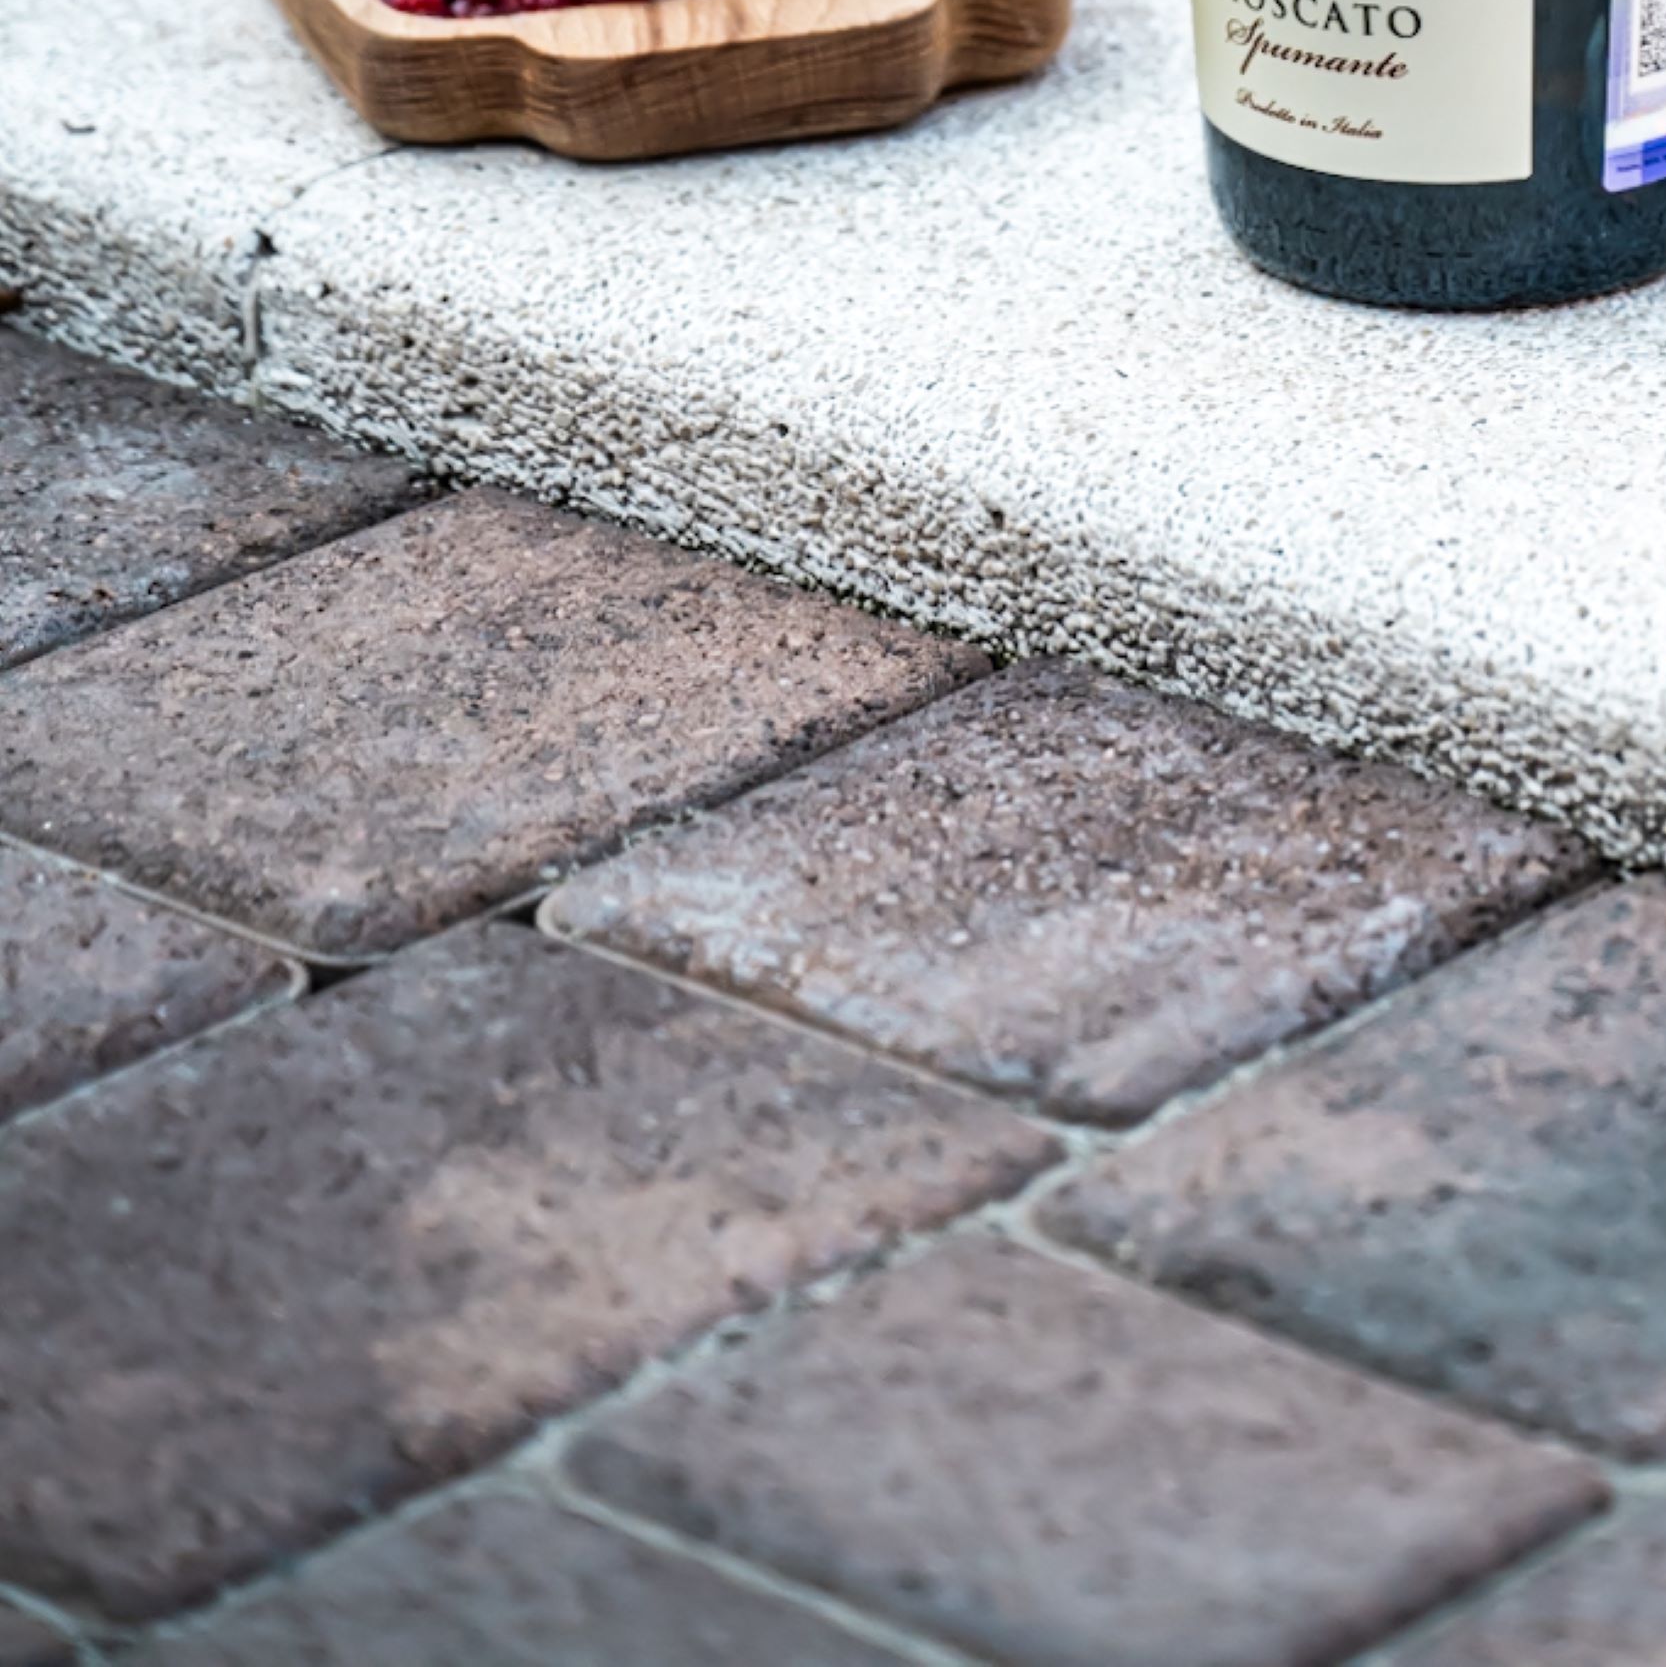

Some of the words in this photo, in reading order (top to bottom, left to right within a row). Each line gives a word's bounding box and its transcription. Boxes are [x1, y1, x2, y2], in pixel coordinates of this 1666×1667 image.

[1224, 17, 1410, 80] Spumante
[1299, 114, 1318, 129] in
[1321, 116, 1382, 138] Italia
